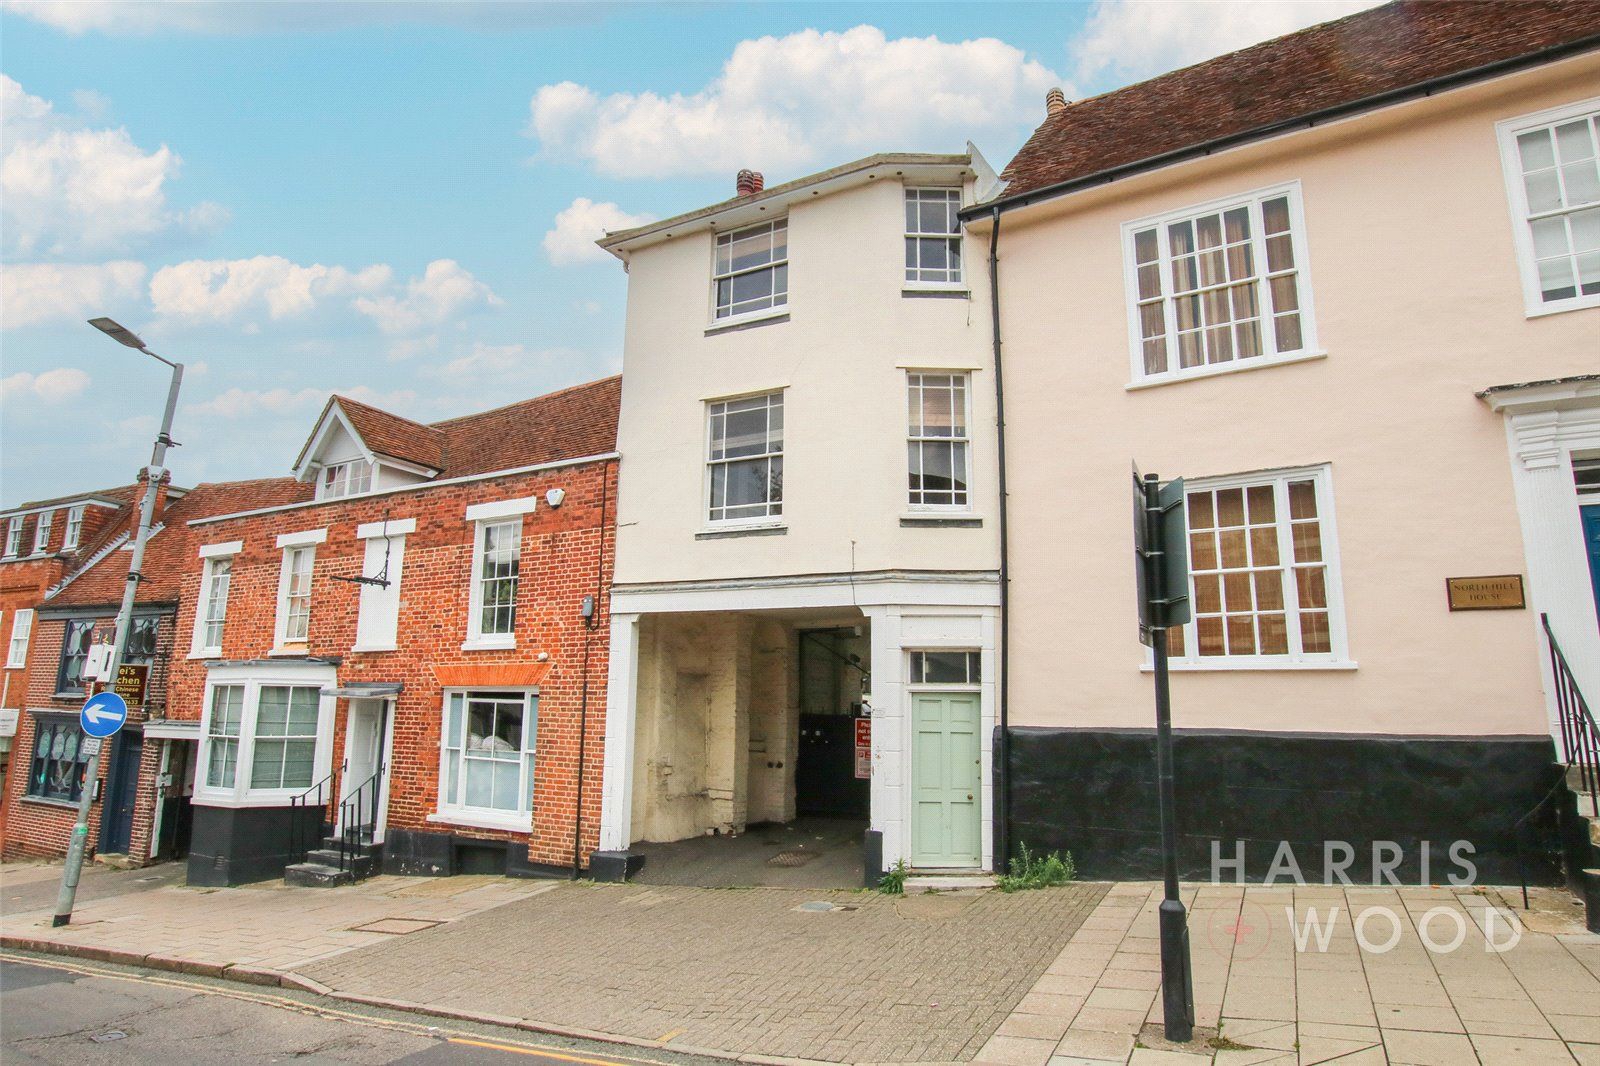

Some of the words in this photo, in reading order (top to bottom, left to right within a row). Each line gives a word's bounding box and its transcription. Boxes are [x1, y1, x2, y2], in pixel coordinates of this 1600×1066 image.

[1454, 583, 1488, 592] NORTH
[1491, 582, 1516, 591] HILL
[1469, 593, 1502, 601] HOUSE
[119, 666, 136, 675] ei's
[116, 676, 140, 685] chen
